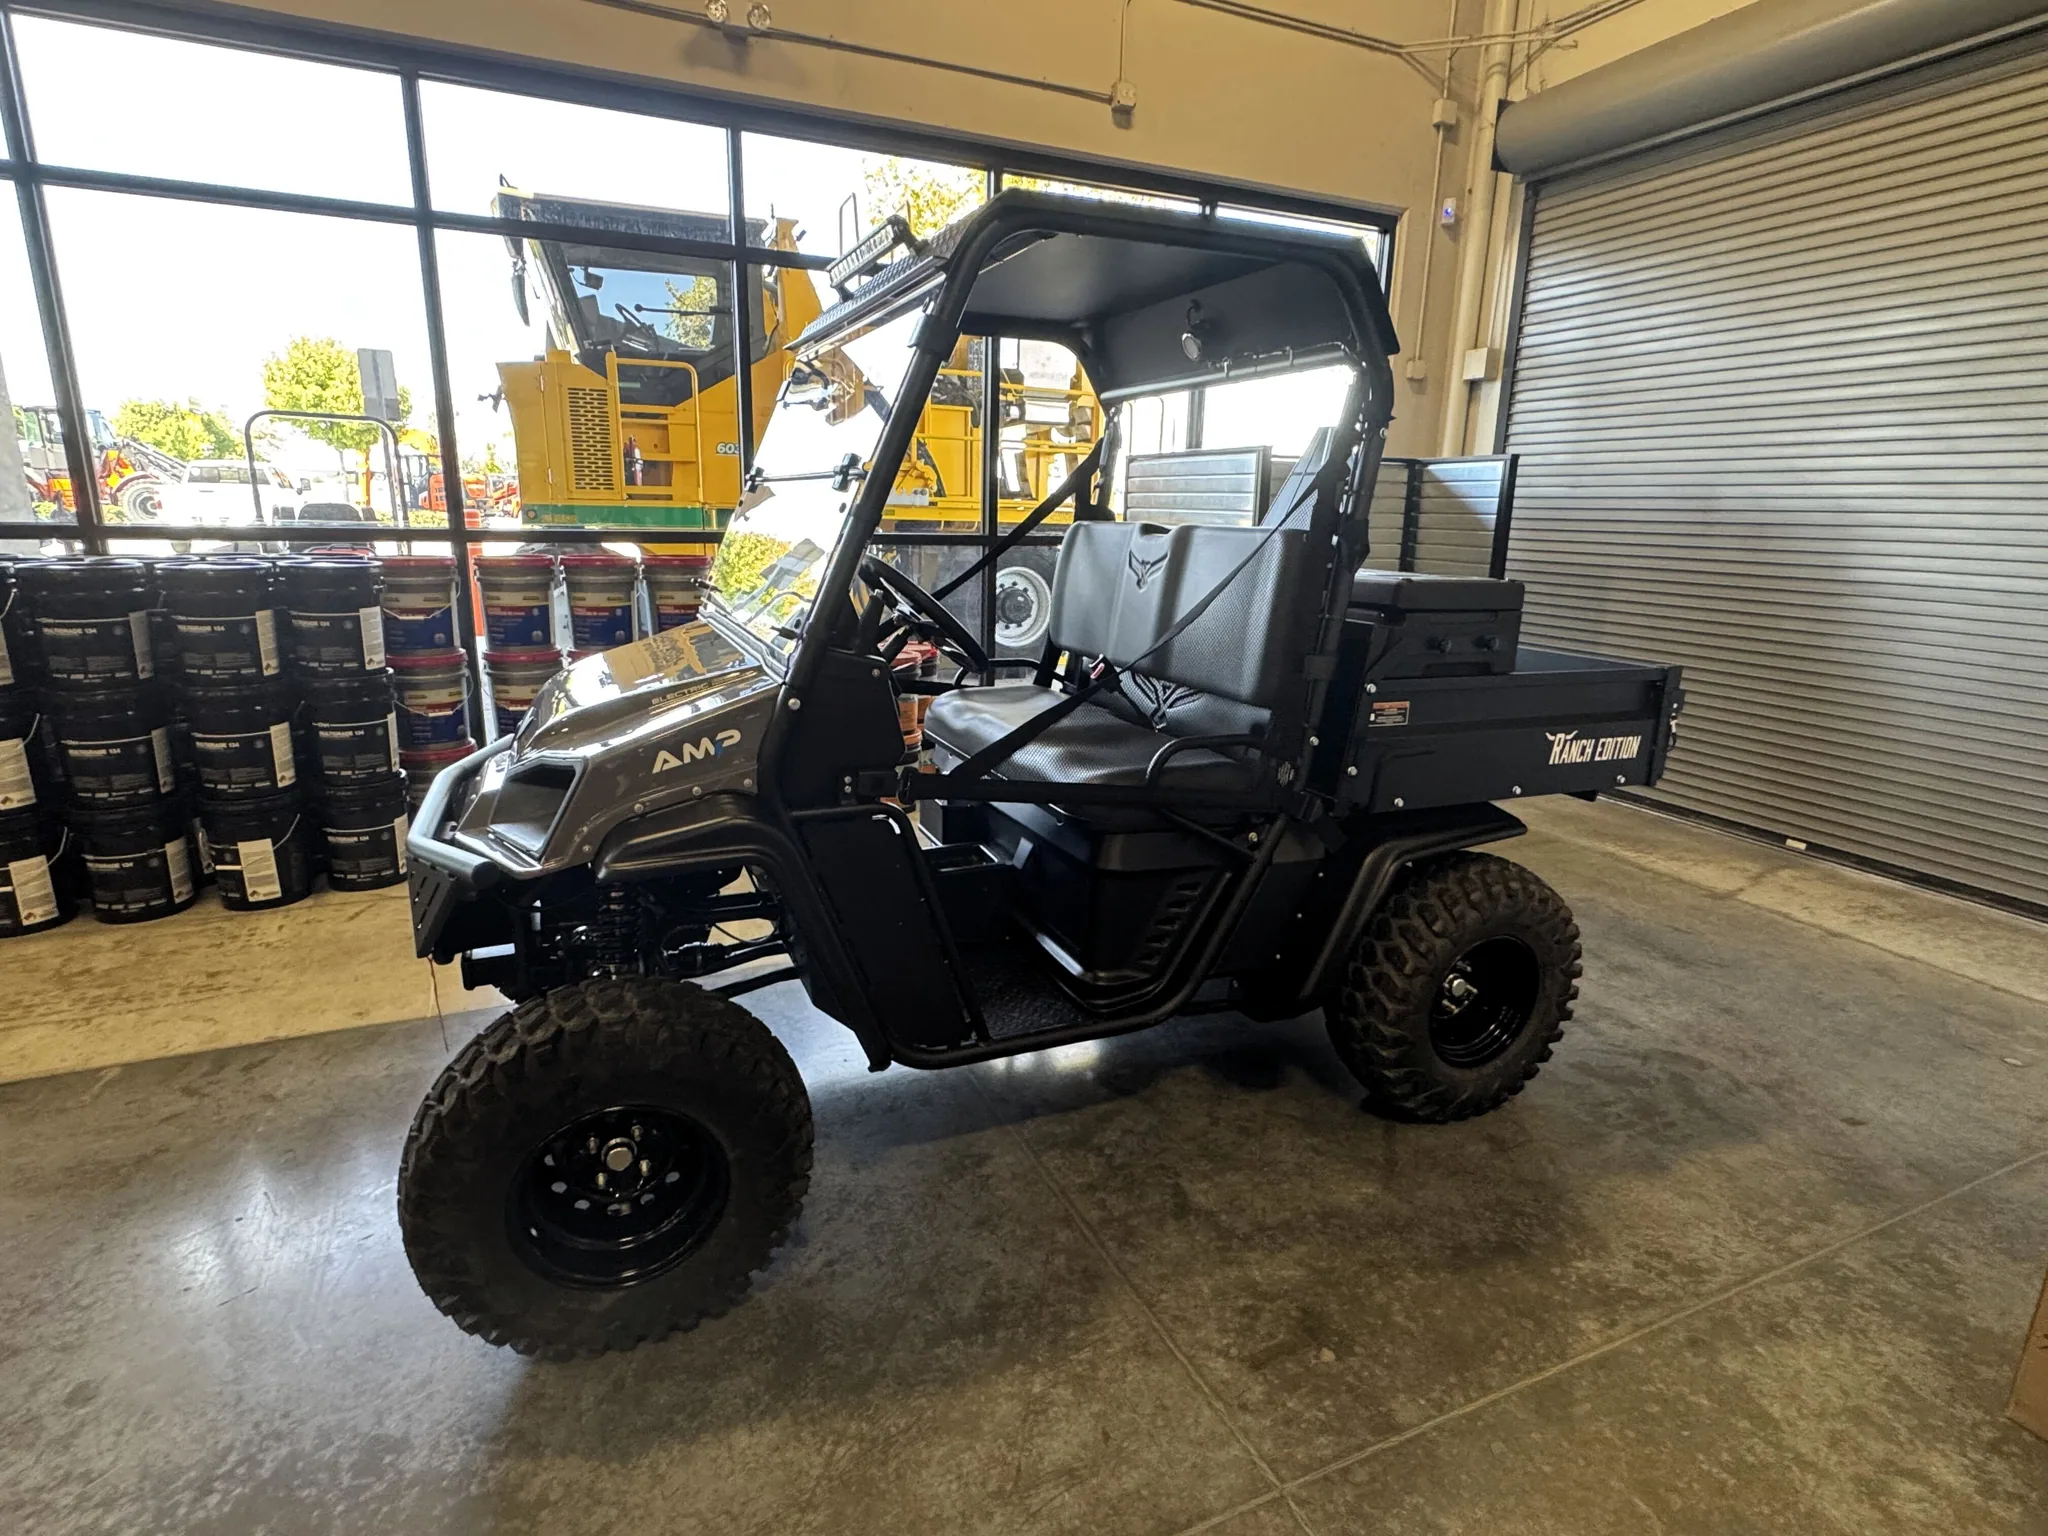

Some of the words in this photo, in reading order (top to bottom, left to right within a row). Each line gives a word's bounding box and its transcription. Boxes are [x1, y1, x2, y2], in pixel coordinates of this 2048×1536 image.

[652, 682, 709, 703] ELECTRIC
[652, 728, 742, 774] AMP
[1548, 732, 1596, 765] RANCH
[1594, 736, 1642, 762] EDITION
